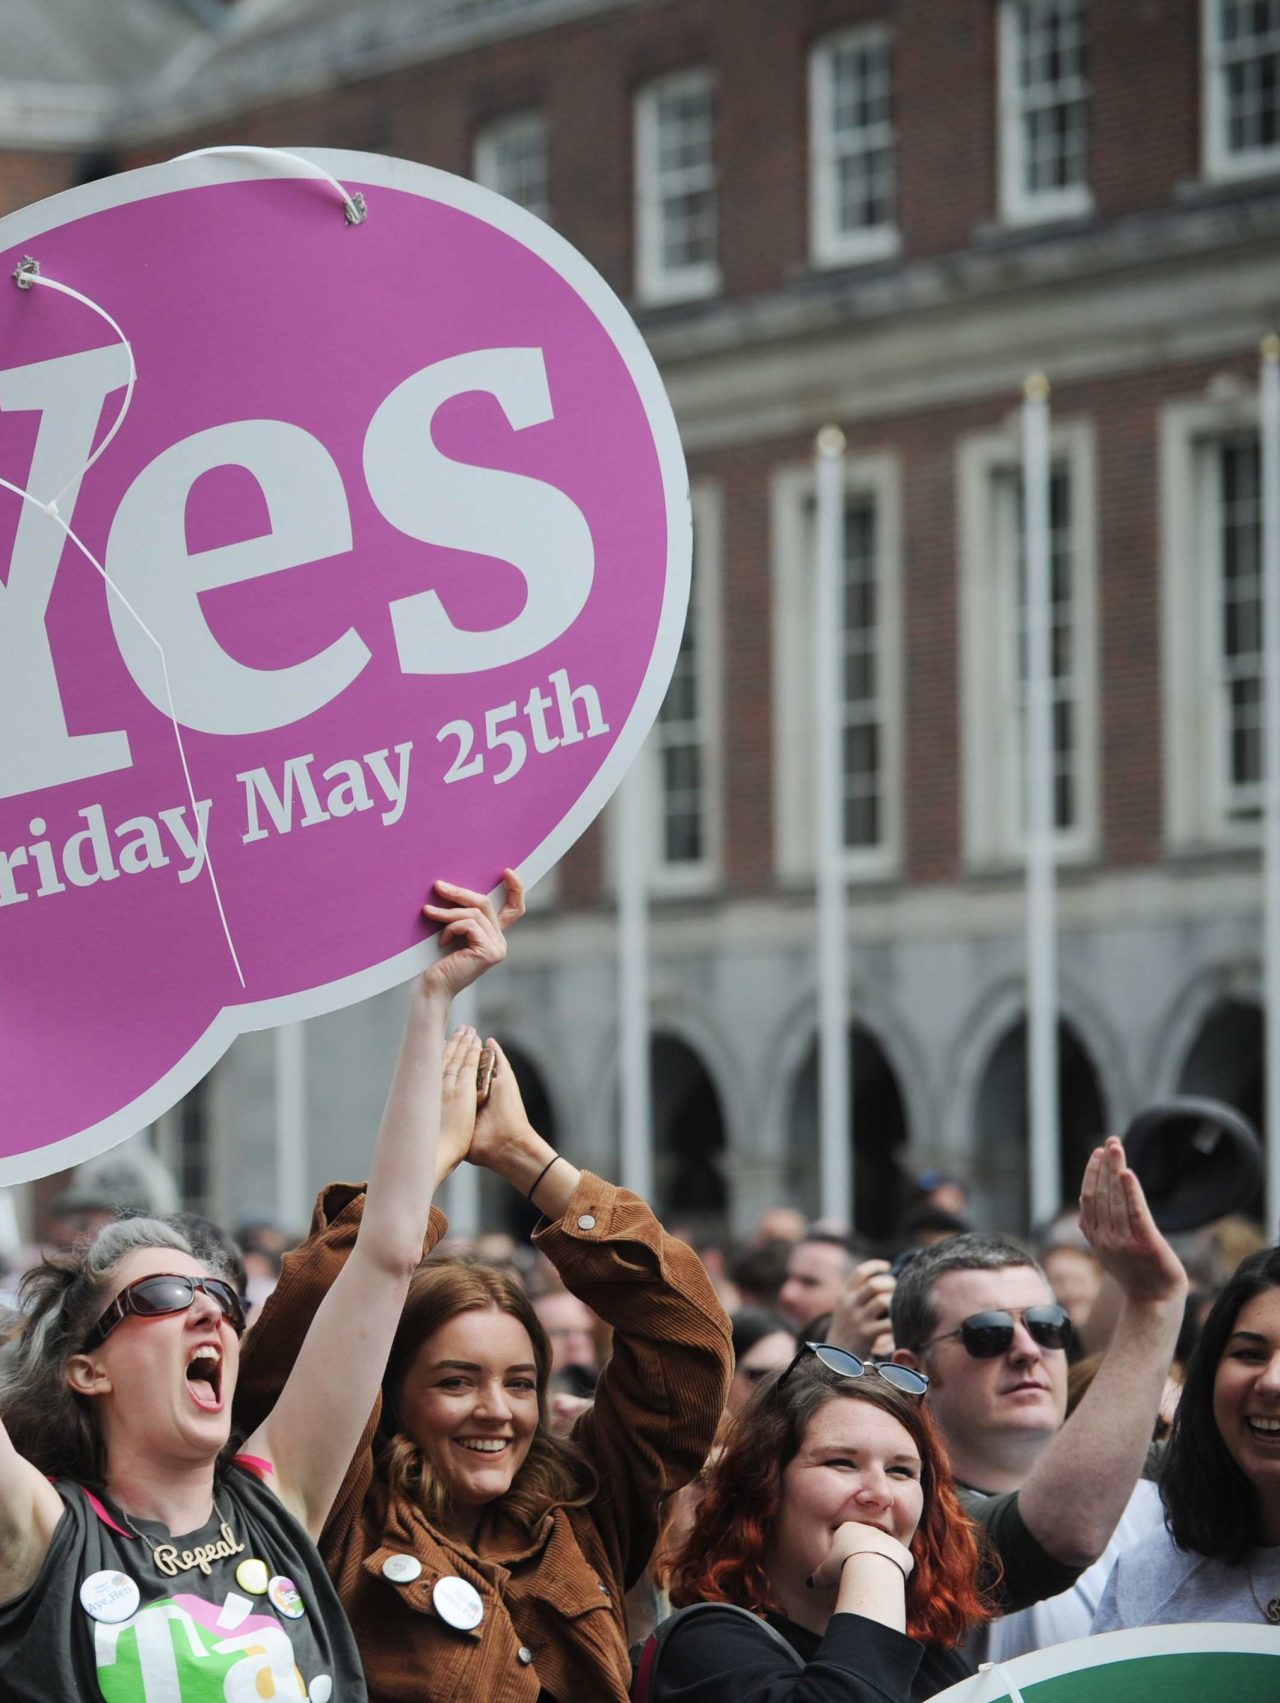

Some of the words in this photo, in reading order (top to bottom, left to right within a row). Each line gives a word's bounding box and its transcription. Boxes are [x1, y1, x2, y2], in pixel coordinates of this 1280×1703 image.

[236, 741, 413, 843] May
[436, 668, 610, 785] 25th
[153, 1522, 245, 1576] Repeal
